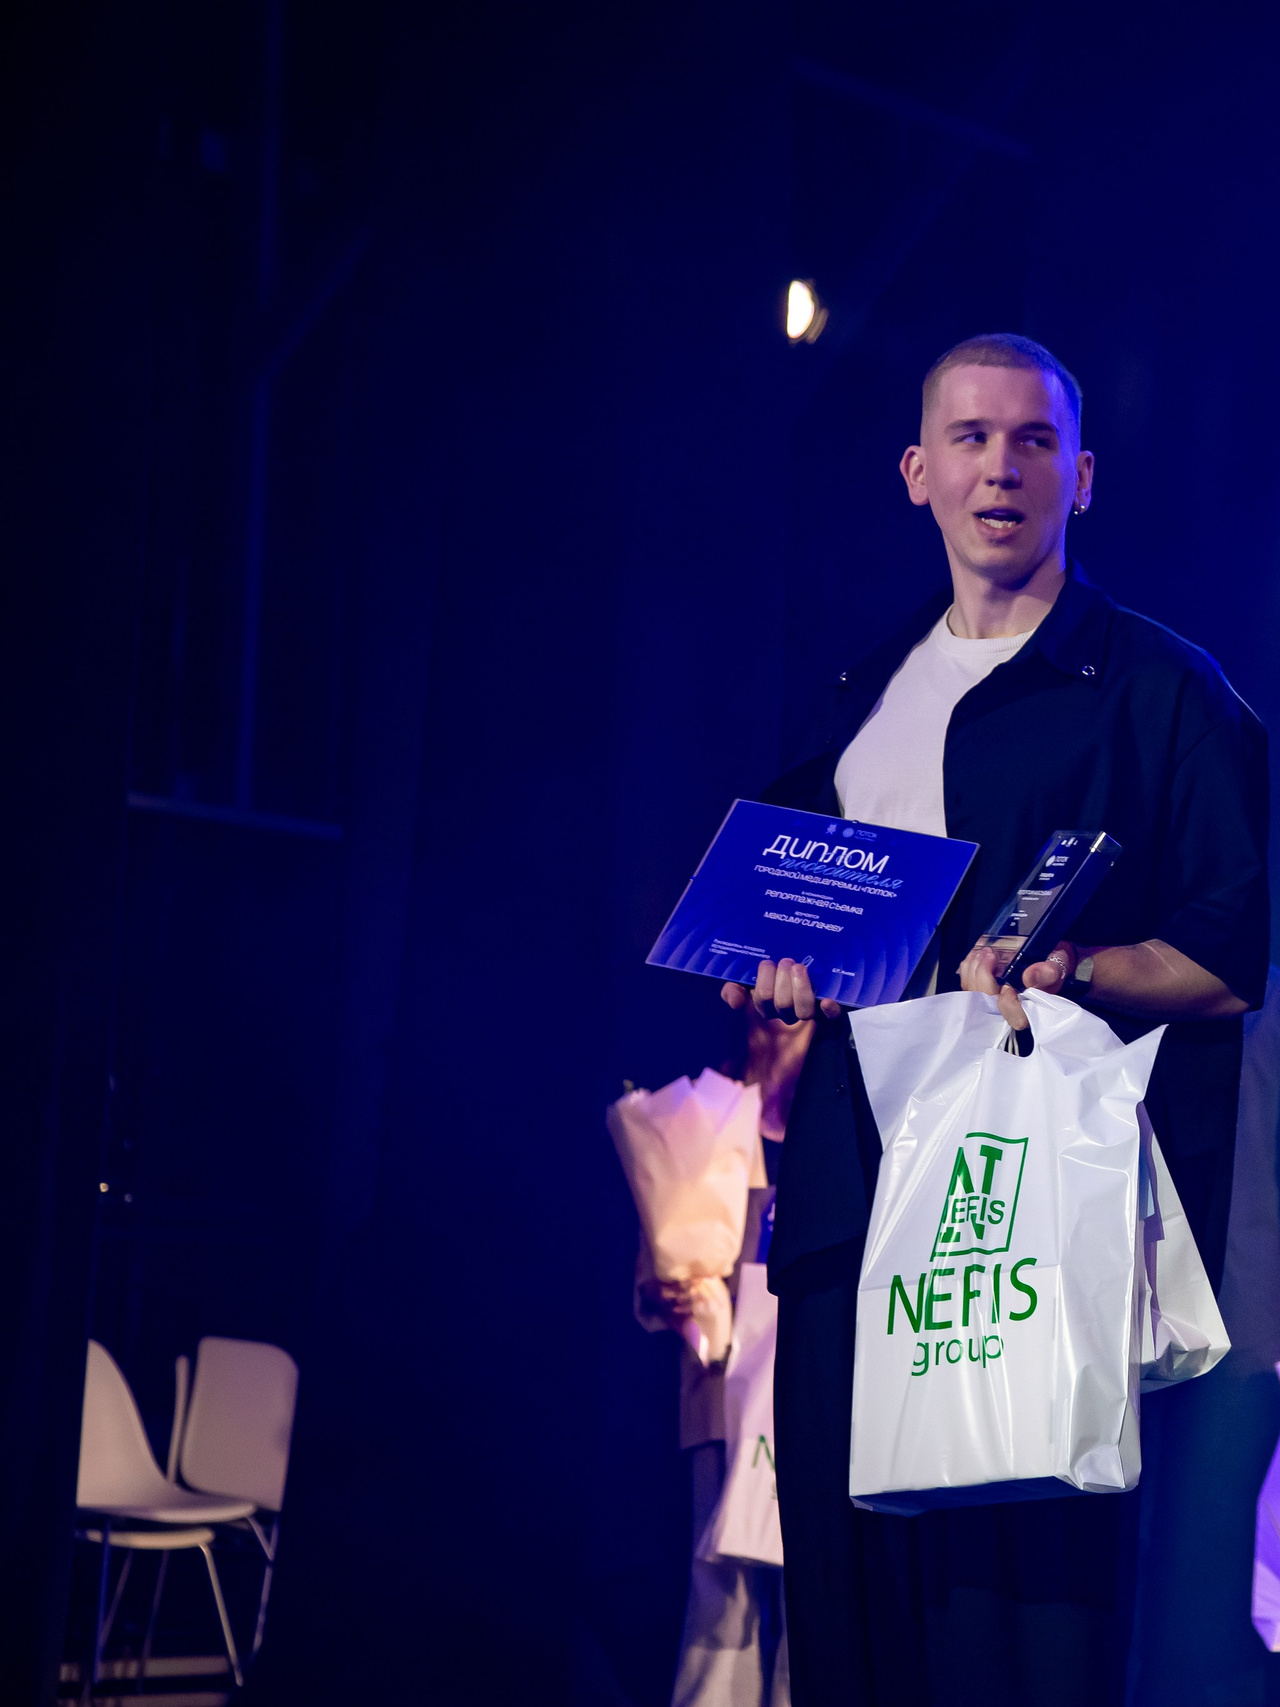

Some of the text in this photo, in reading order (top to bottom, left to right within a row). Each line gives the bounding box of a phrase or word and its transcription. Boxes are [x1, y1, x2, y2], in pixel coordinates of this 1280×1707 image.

[762, 834, 890, 874] ДИПЛОМ
[779, 854, 904, 890] победителя
[886, 1256, 1038, 1335] NEFIS
[910, 1334, 1005, 1377] group
